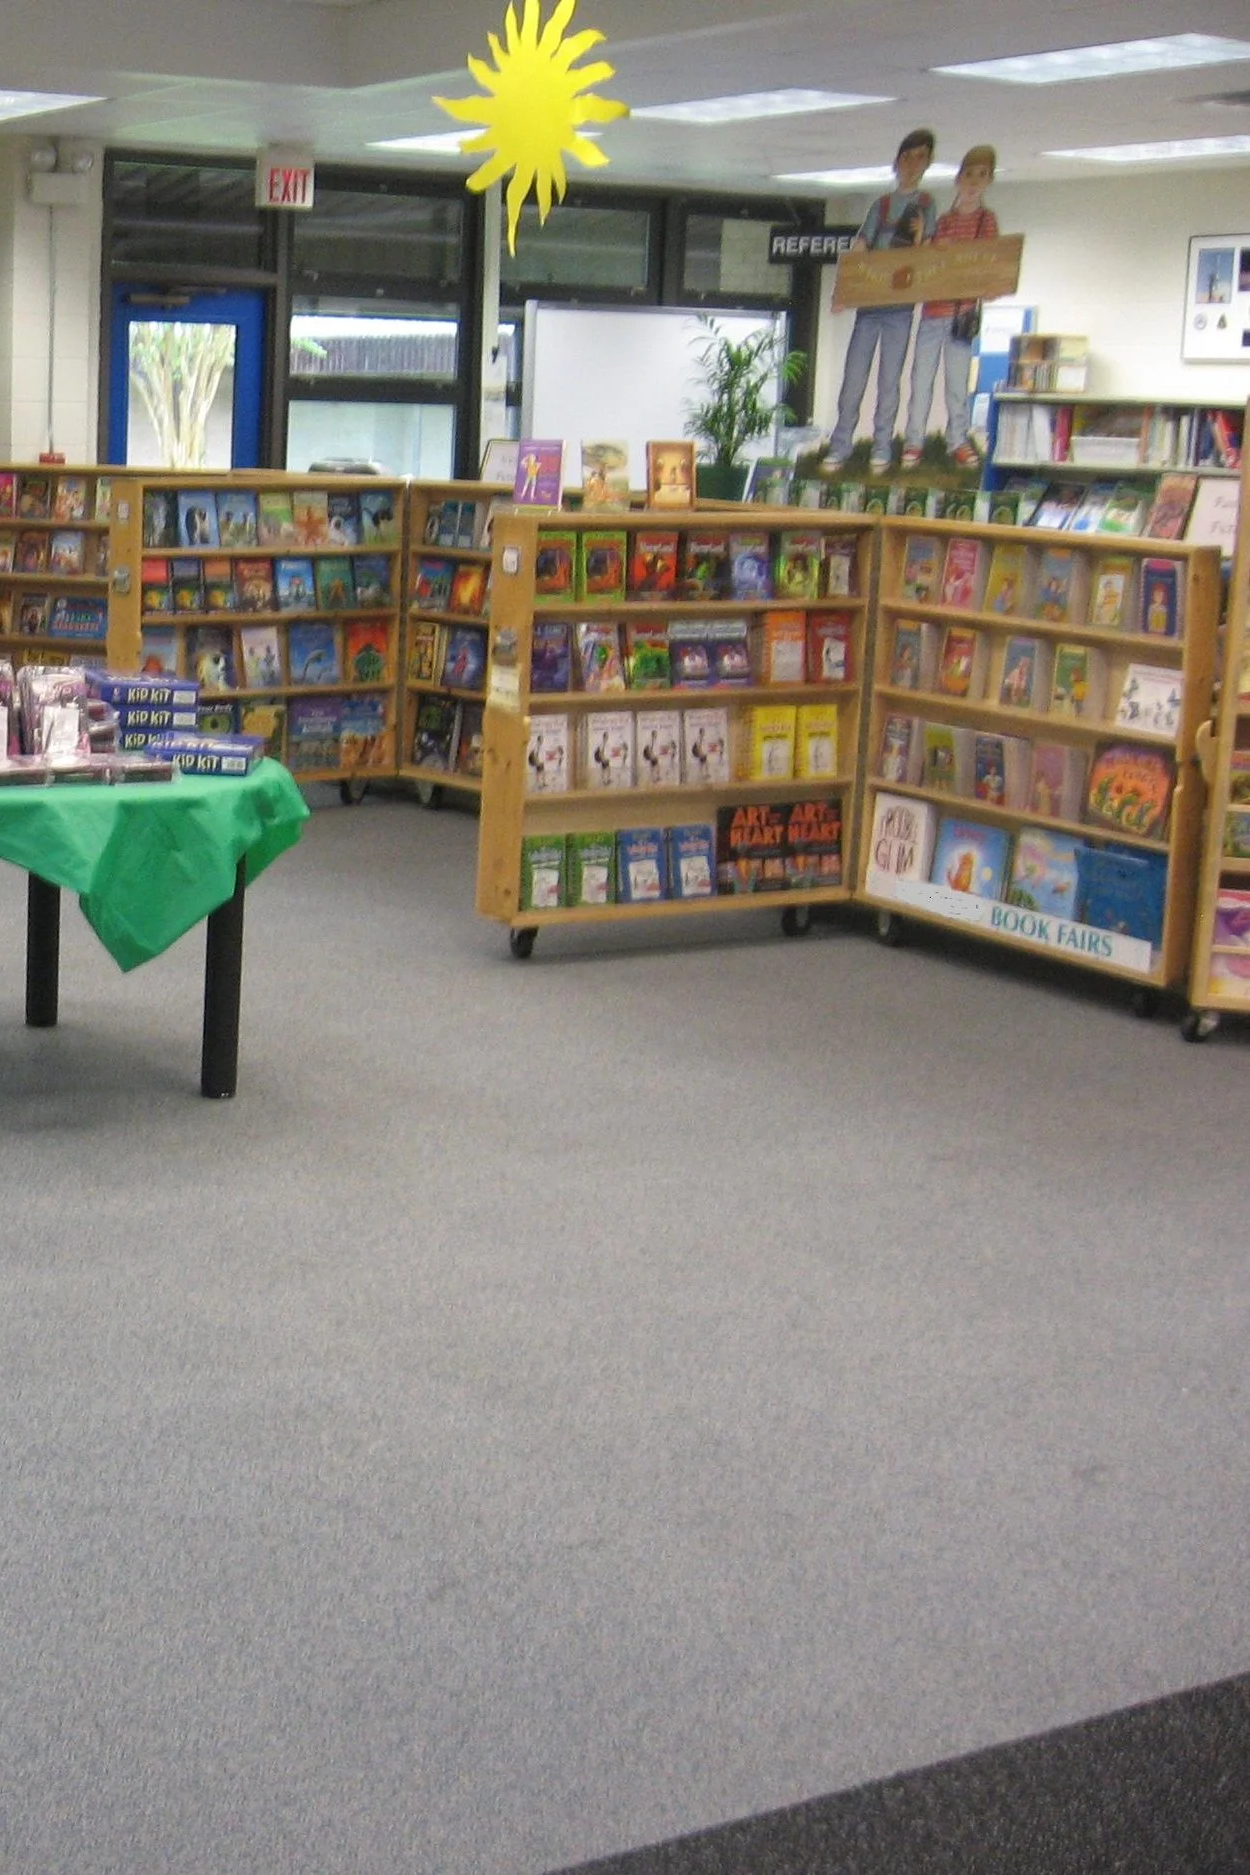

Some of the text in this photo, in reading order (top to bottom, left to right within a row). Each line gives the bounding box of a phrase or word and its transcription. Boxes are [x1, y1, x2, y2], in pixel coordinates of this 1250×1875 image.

[269, 167, 310, 203] EXIT
[772, 235, 853, 256] REFERE
[991, 905, 1113, 957] BOOK FAIRS
